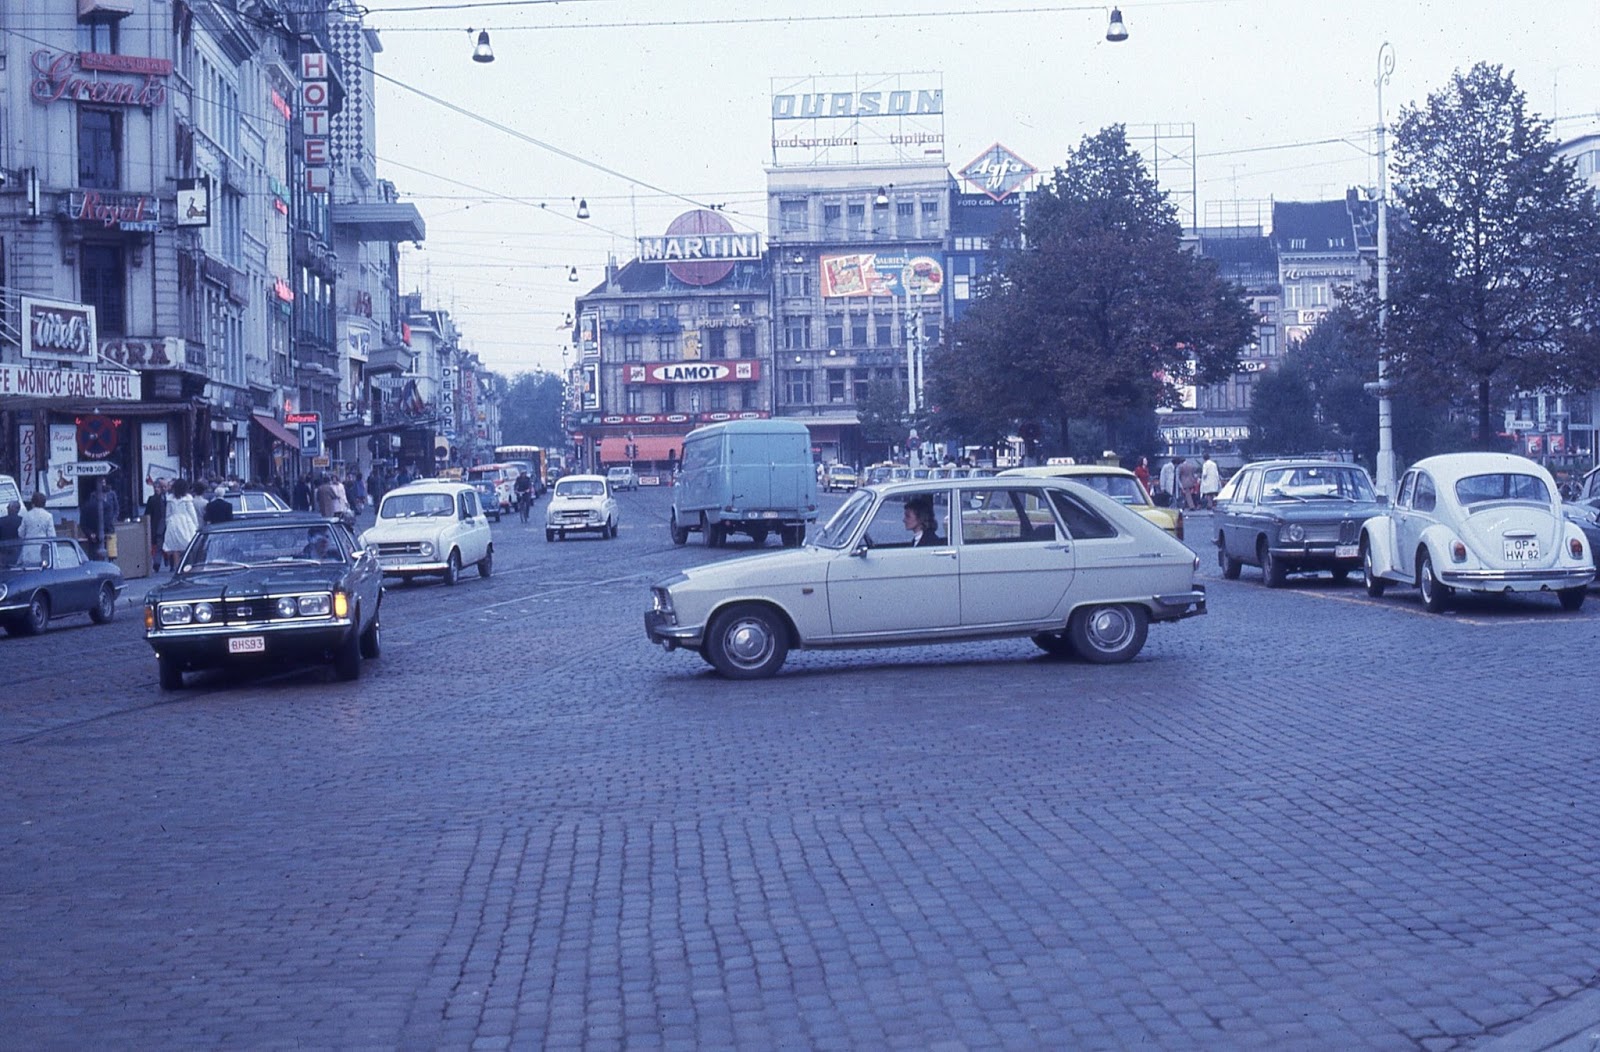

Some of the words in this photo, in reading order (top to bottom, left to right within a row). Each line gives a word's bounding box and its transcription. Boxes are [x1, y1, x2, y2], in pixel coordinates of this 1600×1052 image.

[304, 55, 326, 192] HOTEL
[966, 157, 1024, 189] Agfa
[80, 191, 145, 228] Royal
[643, 236, 757, 260] MARTINI
[18, 369, 61, 394] MONICO
[101, 375, 132, 398] HOTEL
[664, 366, 719, 380] LAMOT
[442, 368, 452, 427] DEKOR
[303, 426, 316, 447] P
[22, 430, 34, 486] Royal
[67, 465, 73, 473] P
[1506, 551, 1524, 560] HW
[1528, 550, 1539, 559] 82
[1514, 541, 1529, 549] OP
